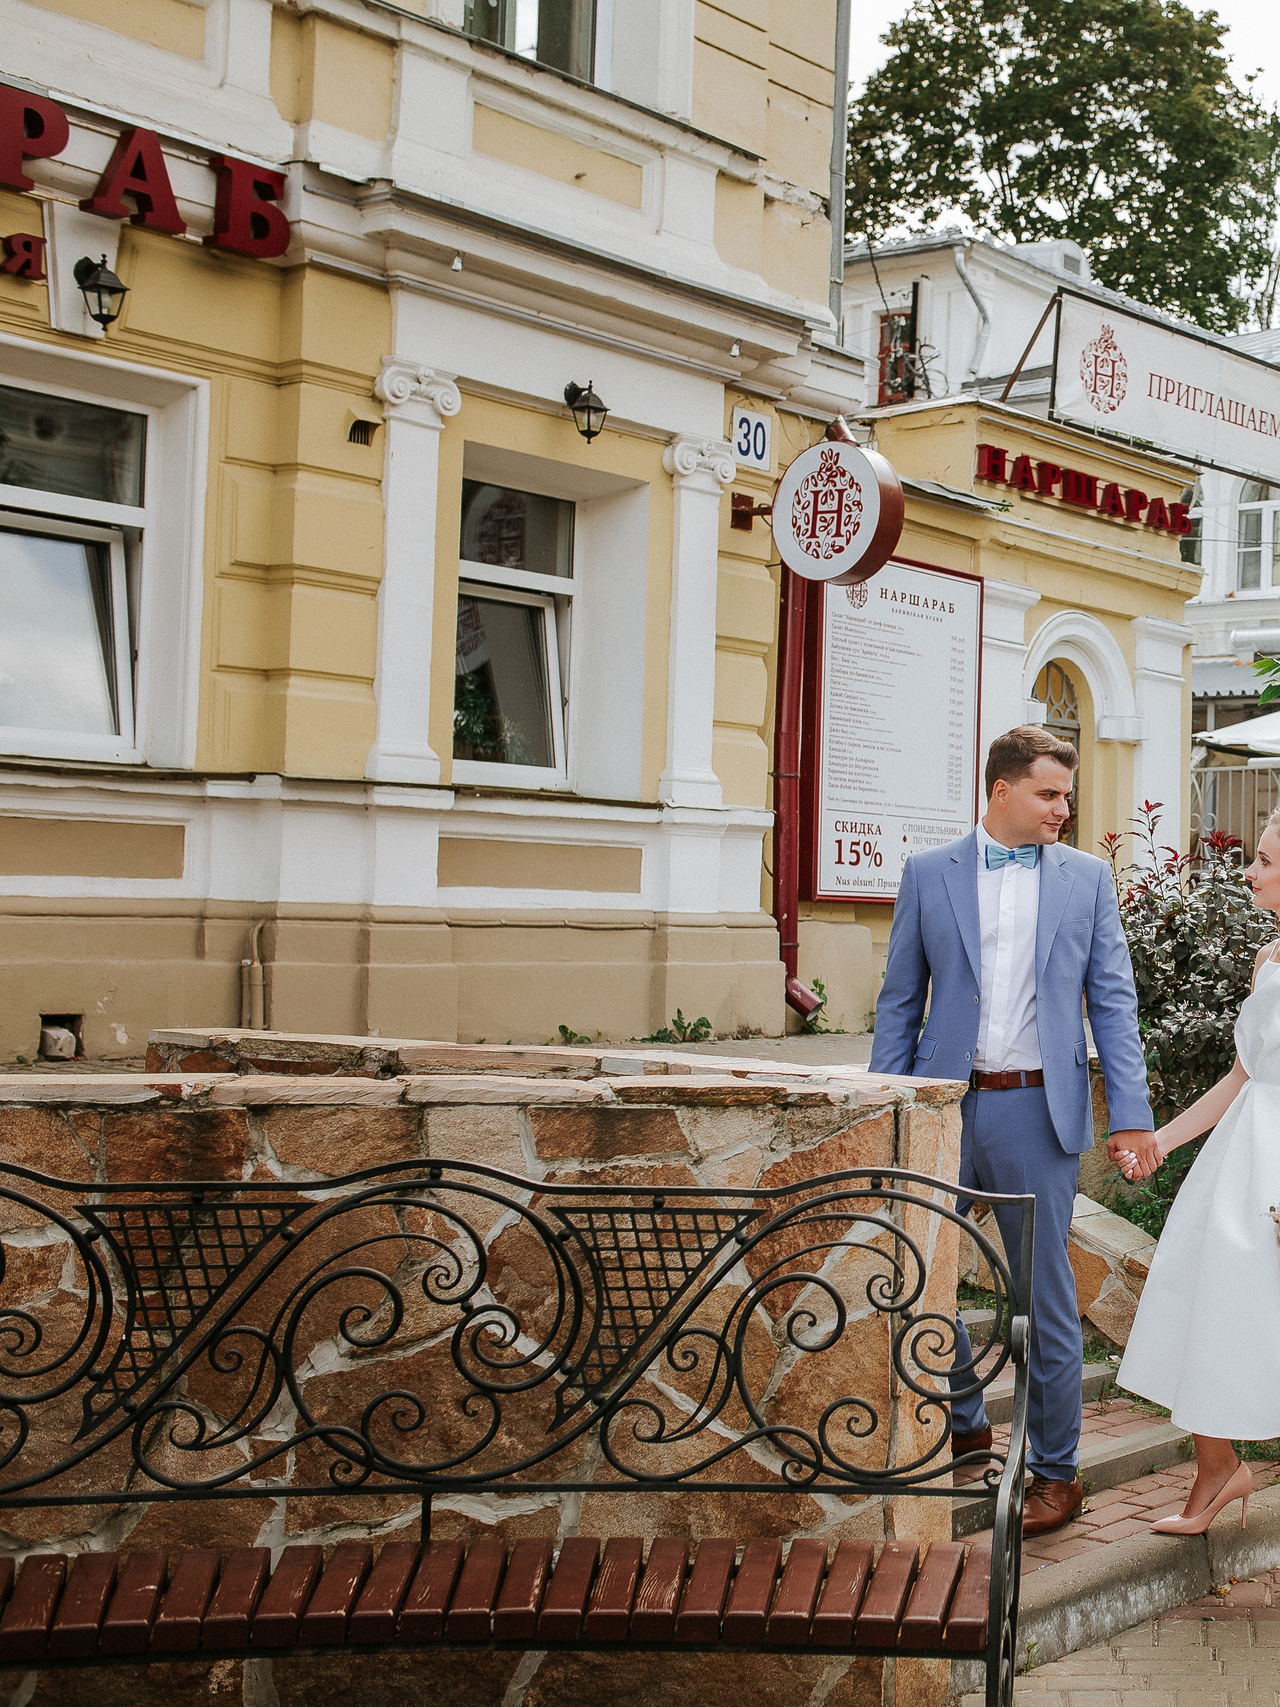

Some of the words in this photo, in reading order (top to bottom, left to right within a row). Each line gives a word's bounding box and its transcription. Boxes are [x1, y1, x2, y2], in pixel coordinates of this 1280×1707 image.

[737, 416, 766, 461] 30
[976, 443, 1193, 535] НАРШАРАБ
[880, 587, 955, 615] НАРШАРАБ
[834, 820, 882, 838] СКИДКА
[902, 823, 907, 832] С
[908, 824, 962, 837] ПОНЕДЕЛЬНИКА
[913, 836, 923, 845] ПО
[834, 837, 883, 869] 15%
[835, 875, 851, 886] Nus
